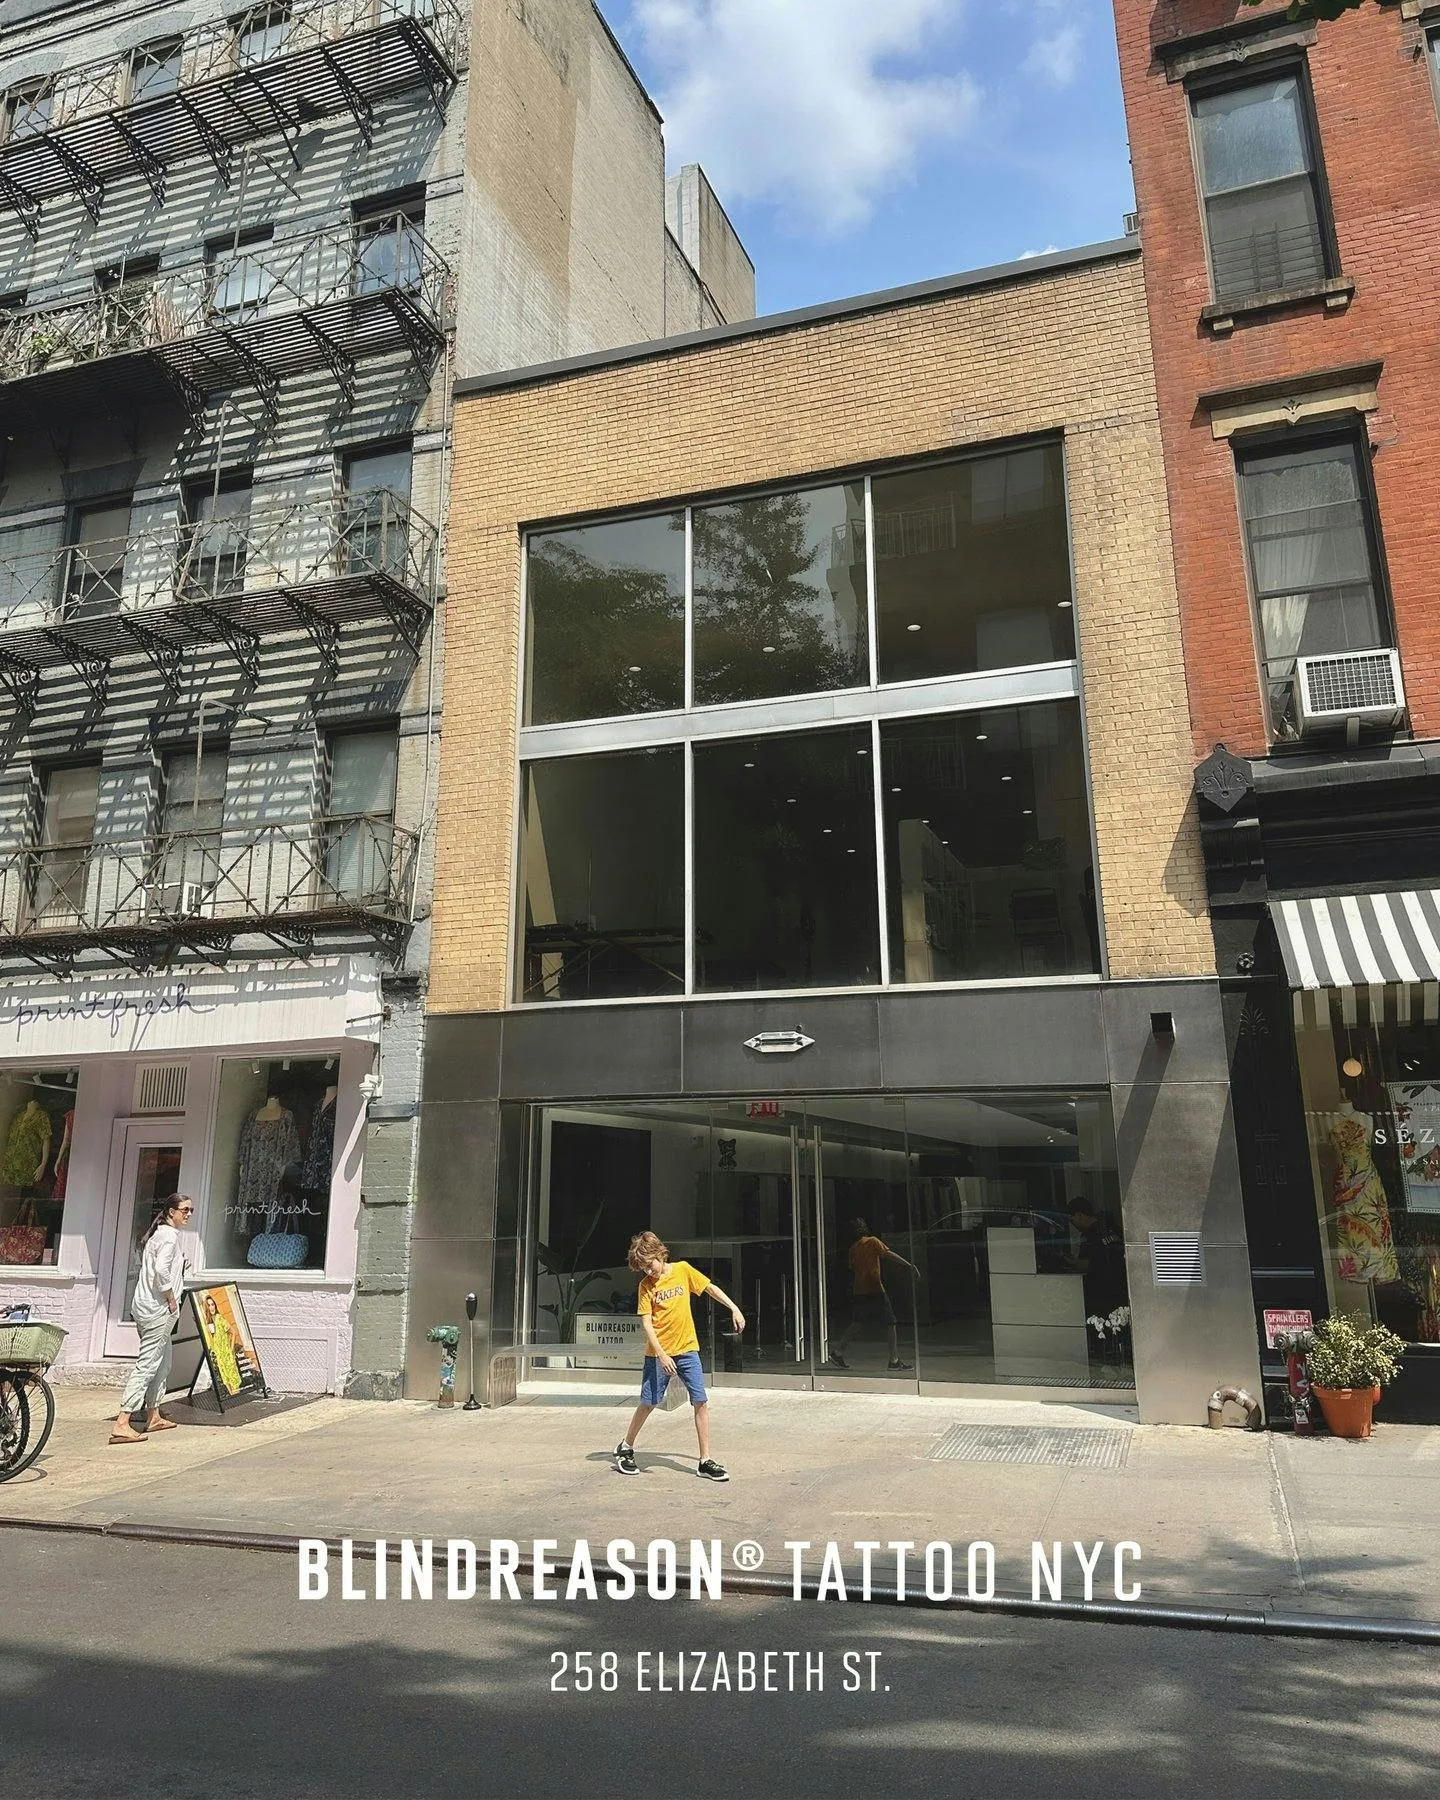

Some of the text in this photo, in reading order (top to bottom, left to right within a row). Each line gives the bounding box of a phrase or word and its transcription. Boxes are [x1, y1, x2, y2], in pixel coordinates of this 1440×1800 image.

[0, 982, 216, 1043] printfresh
[222, 1198, 322, 1224] printfresh
[655, 1286, 684, 1305] LAKERS
[1267, 1313, 1309, 1323] SPRINKLERS
